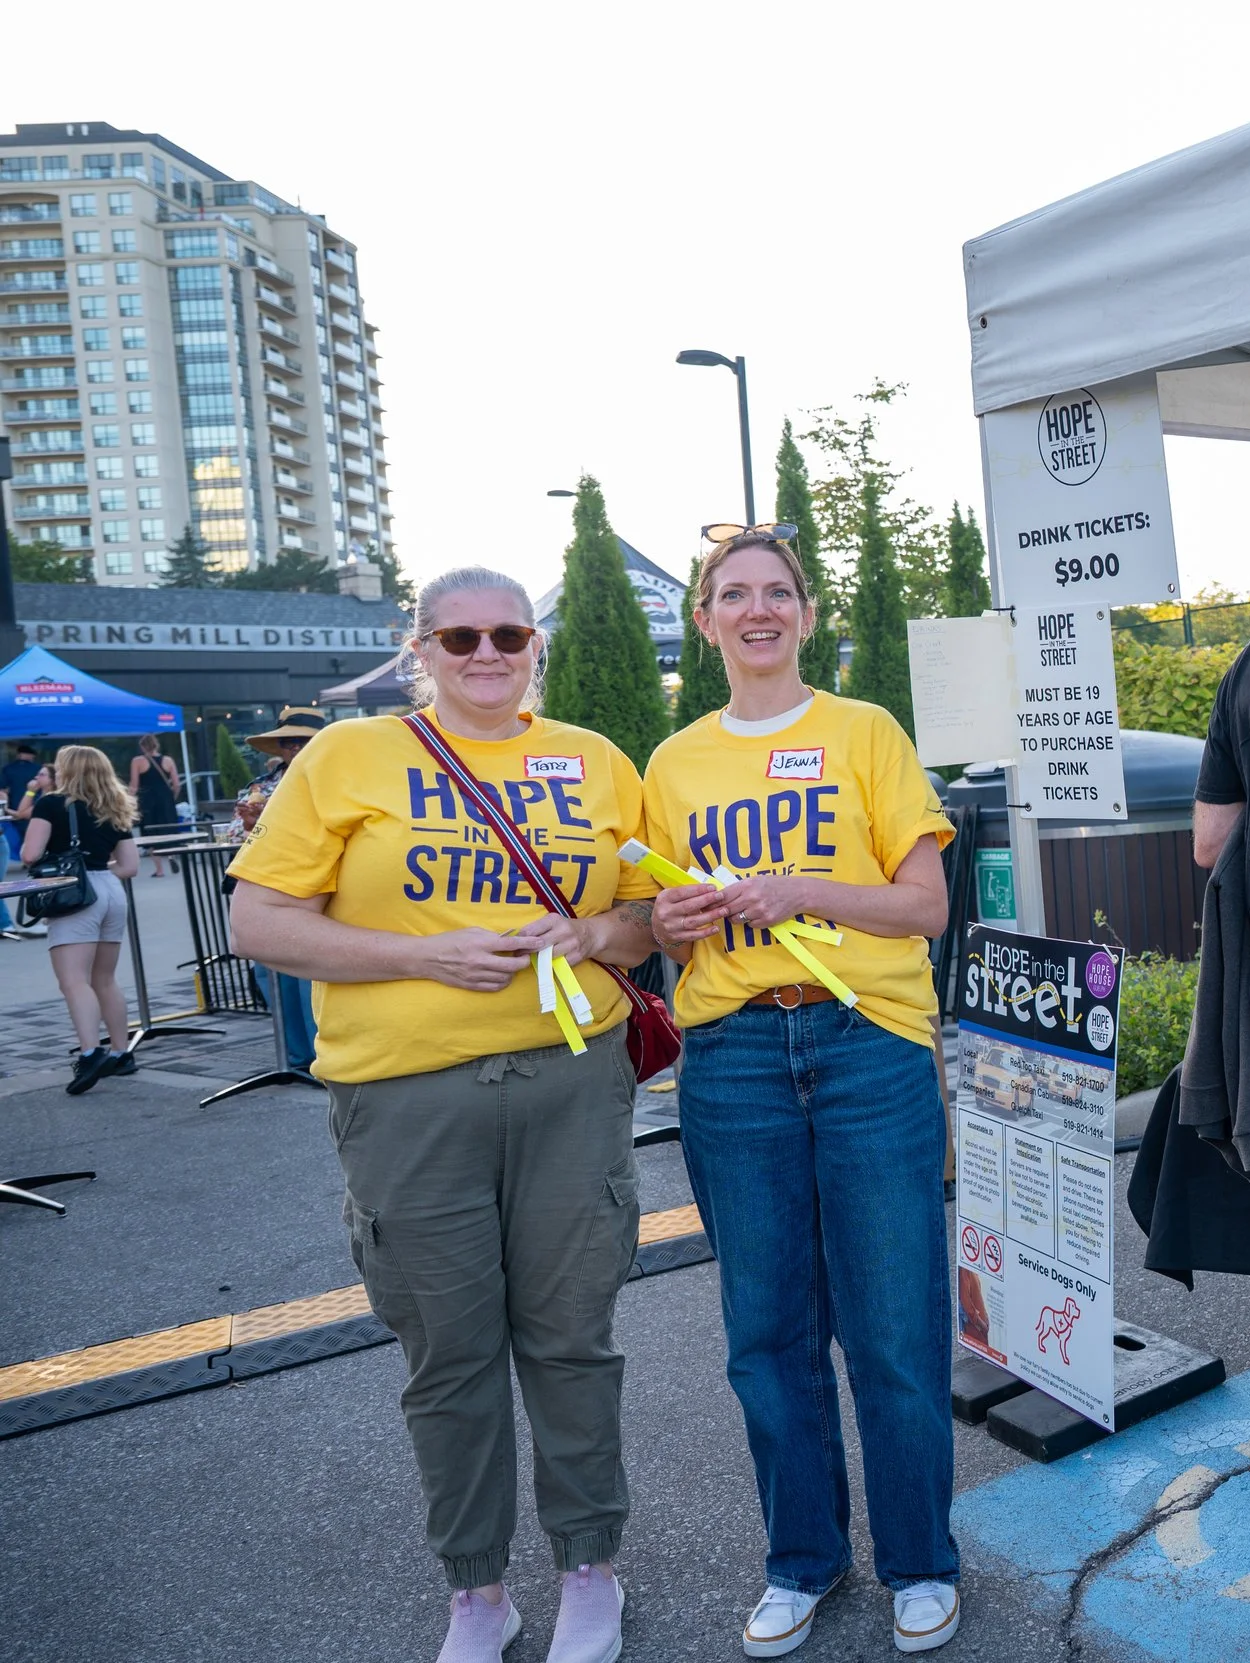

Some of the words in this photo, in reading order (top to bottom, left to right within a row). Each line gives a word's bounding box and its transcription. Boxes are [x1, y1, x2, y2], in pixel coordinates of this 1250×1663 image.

[1046, 400, 1095, 442] HOPE
[1060, 440, 1069, 448] IN
[1071, 436, 1085, 445] THE
[1051, 442, 1096, 471] STREET
[1018, 524, 1071, 549] DRINK
[1075, 512, 1150, 538] TICKETS:
[1055, 552, 1119, 587] $9.00
[1038, 613, 1075, 640] HOPE
[1041, 647, 1076, 666] STREET
[15, 696, 57, 705] CLEAR
[1026, 688, 1060, 702] MUST
[1064, 687, 1081, 700] BE
[1086, 686, 1100, 700] 19
[1017, 713, 1059, 727] YEARS
[1063, 712, 1080, 726] OF
[1085, 711, 1113, 725] AGE
[1020, 738, 1037, 752] TO
[1041, 736, 1113, 751] PURCHASE
[530, 760, 567, 771] Tara
[773, 755, 820, 769] JENNA
[1048, 761, 1089, 776] DRINK
[407, 767, 592, 829] HOPE
[1043, 786, 1098, 801] TICKETS
[464, 825, 489, 844] IN
[689, 785, 838, 877] HOPE
[990, 943, 1029, 975] HOPE
[1031, 956, 1042, 977] in
[1044, 959, 1065, 981] the
[1092, 964, 1110, 975] HOPE
[965, 941, 1082, 1033] street
[1089, 973, 1111, 986] HOUSE
[1092, 1013, 1109, 1029] HOPE
[1091, 1031, 1108, 1043] STREET
[964, 1048, 978, 1059] Local
[964, 1064, 975, 1075] Taxi
[1010, 1057, 1021, 1068] Red
[1021, 1062, 1032, 1073] Top
[1033, 1064, 1044, 1075] Taxi
[1011, 1080, 1036, 1095] Canadian
[1037, 1087, 1049, 1099] Cab
[1062, 1072, 1104, 1093] 519-821-1700
[1011, 1102, 1032, 1117] Guelph
[1032, 1108, 1043, 1120] Taxi
[1062, 1095, 1104, 1115] 519-824-3110
[1064, 1119, 1103, 1139] 519-821-1414
[1061, 1156, 1071, 1166] Safe
[1063, 1174, 1077, 1184] Please
[1064, 1196, 1076, 1206] phone
[1077, 1201, 1096, 1214] numbers
[1083, 1192, 1096, 1202] There
[1065, 1228, 1073, 1236] you
[1066, 1239, 1081, 1250] reduce
[1018, 1253, 1049, 1277] Service
[1051, 1268, 1073, 1289] Dogs
[1076, 1280, 1096, 1302] Only
